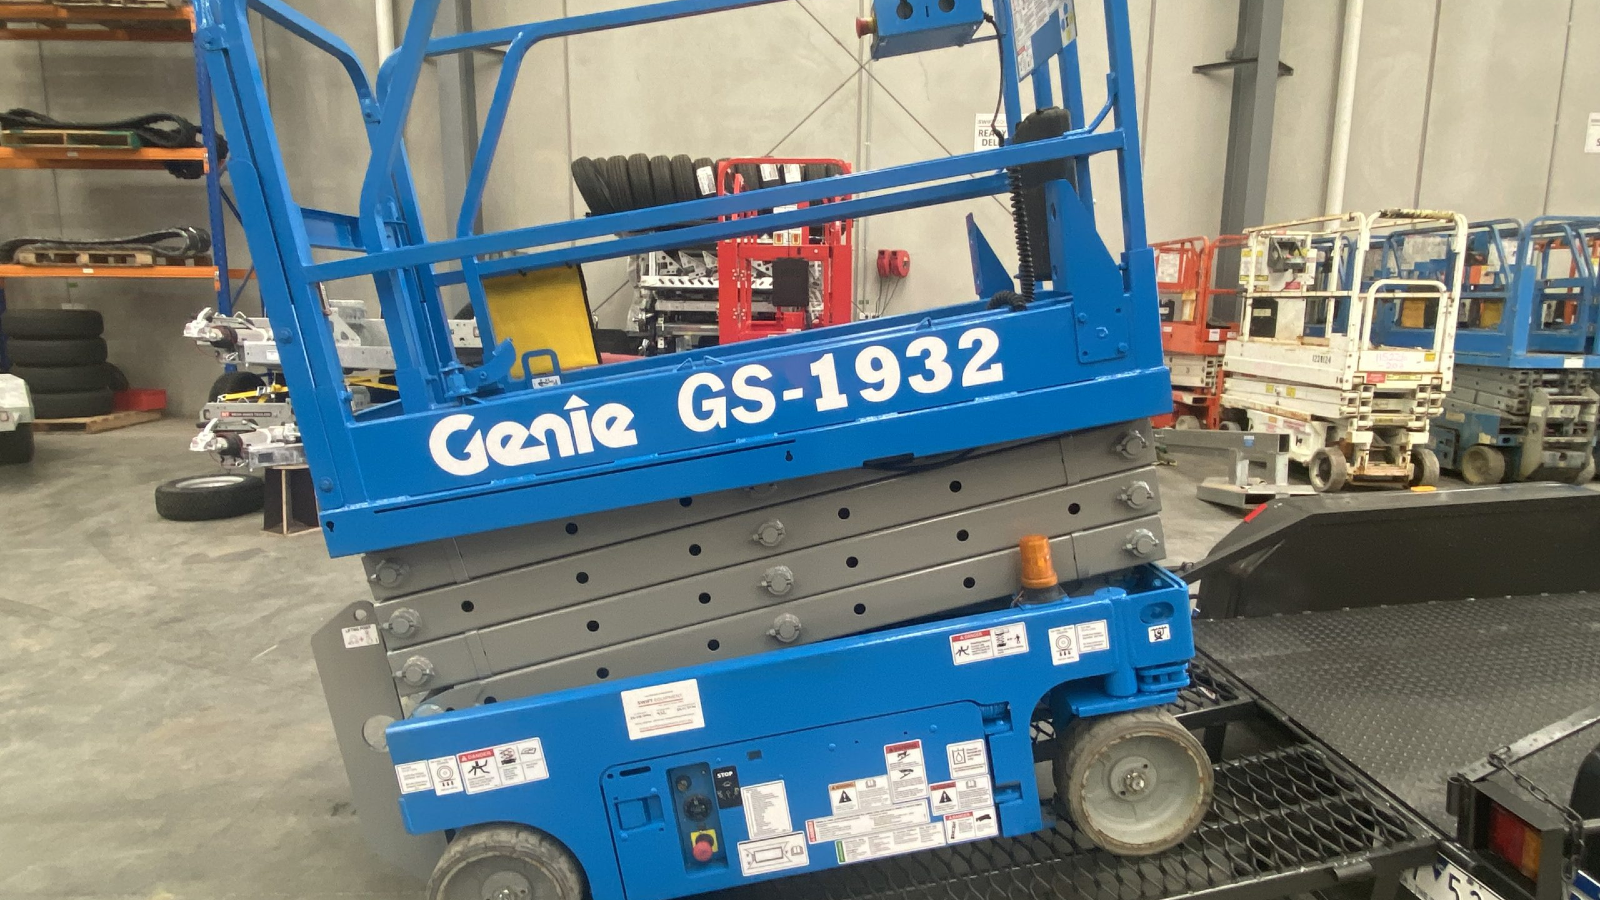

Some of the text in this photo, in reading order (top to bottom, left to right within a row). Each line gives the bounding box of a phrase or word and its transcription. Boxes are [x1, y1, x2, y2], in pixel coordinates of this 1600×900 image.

[978, 129, 1006, 137] REAY
[429, 327, 1004, 476] Genie GS-1932
[467, 751, 493, 760] DANGER
[716, 770, 734, 779] STOP
